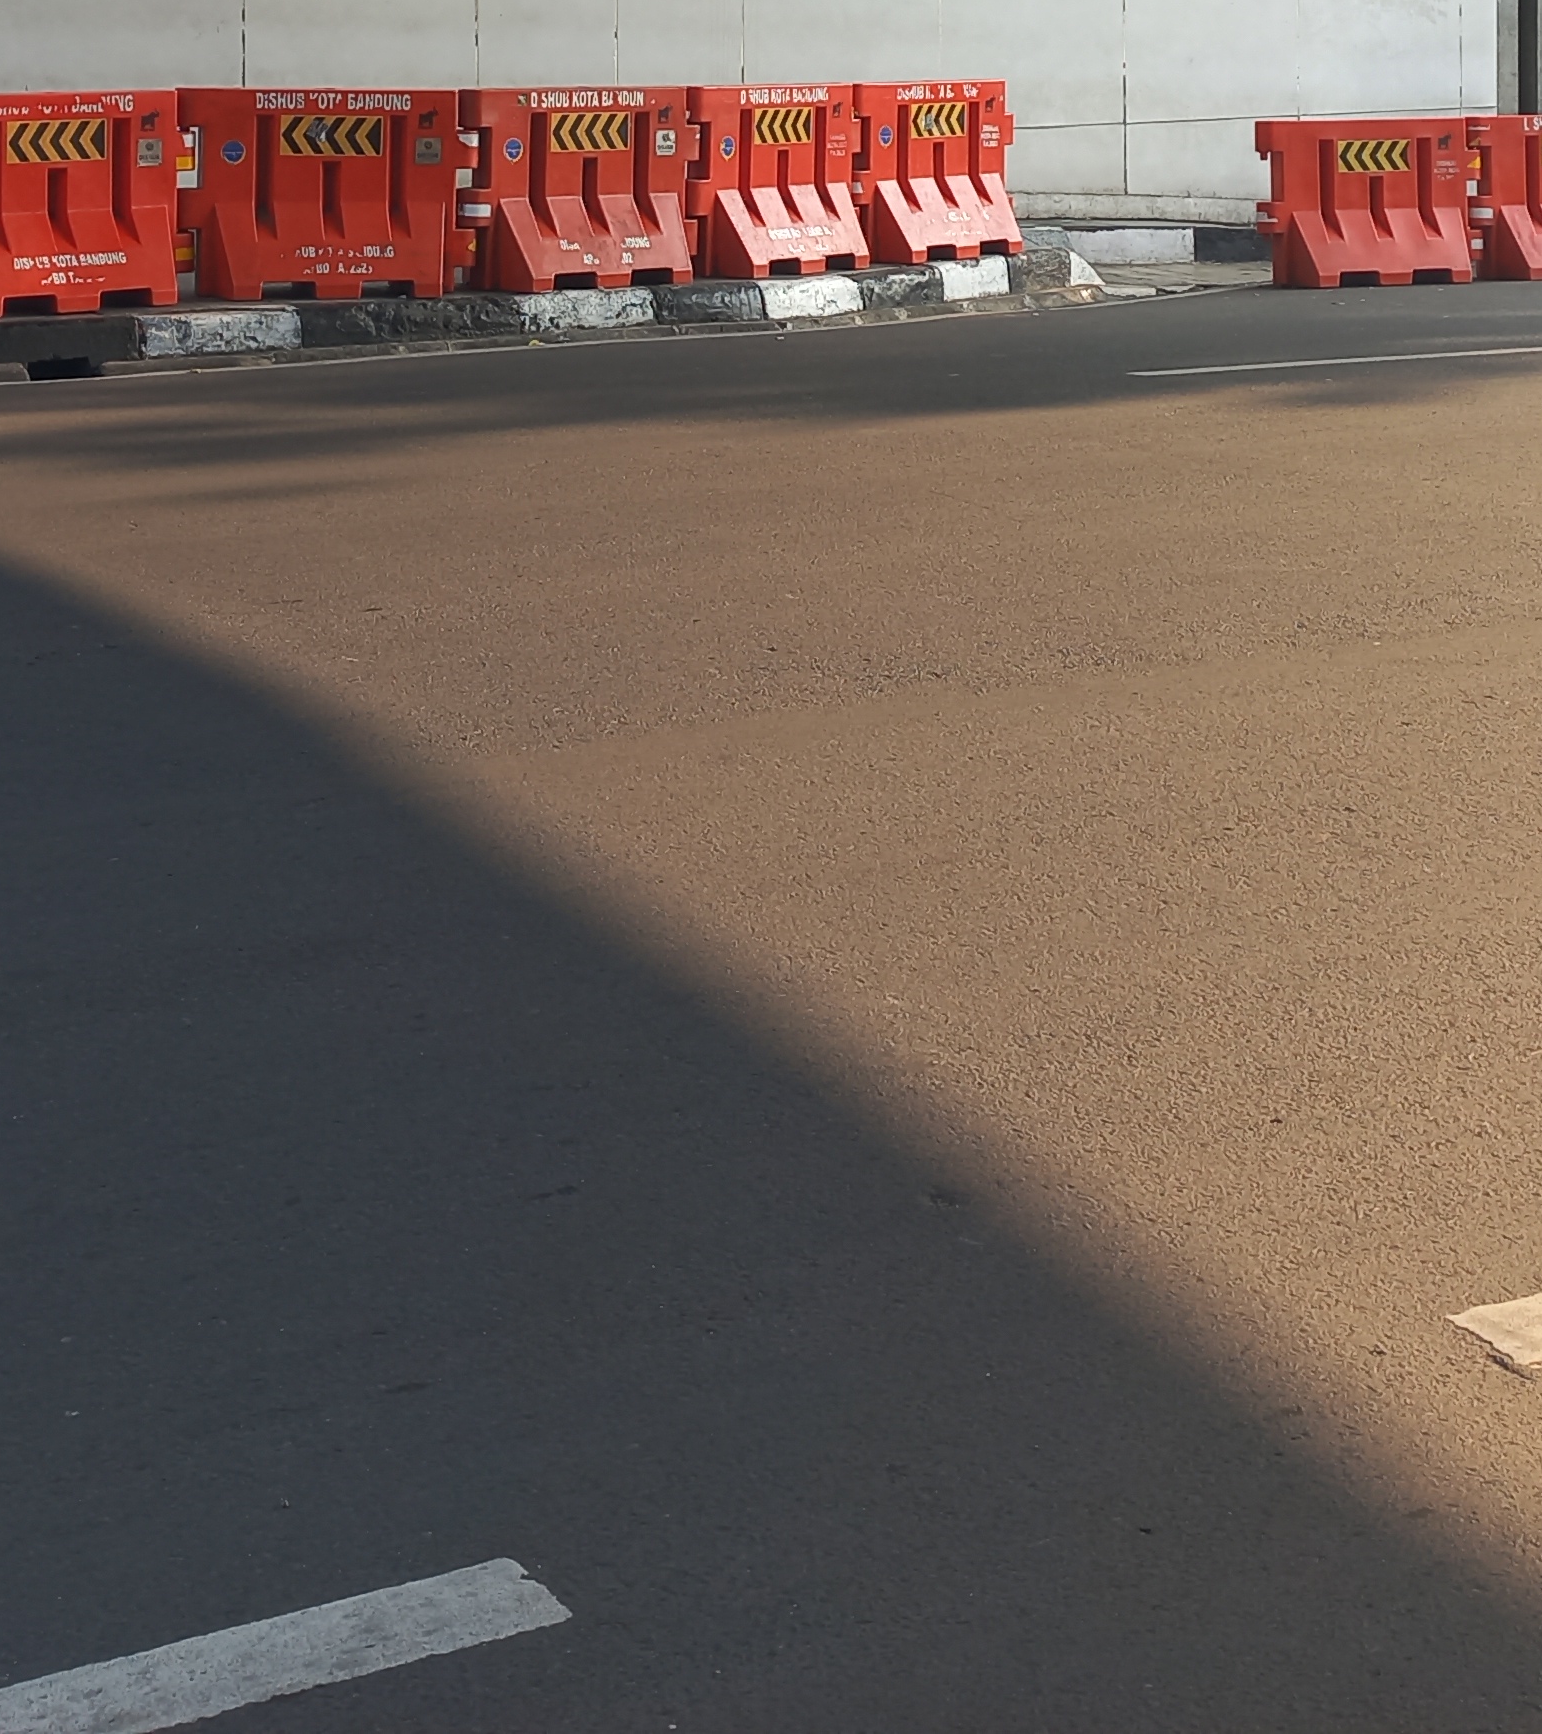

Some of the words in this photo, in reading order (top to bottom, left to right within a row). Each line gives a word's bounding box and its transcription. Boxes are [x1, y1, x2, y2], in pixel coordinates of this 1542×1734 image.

[531, 92, 569, 107] DSHUB
[572, 91, 599, 106] KOTA
[741, 88, 769, 104] DSHUB
[79, 252, 126, 266] BANDUNG
